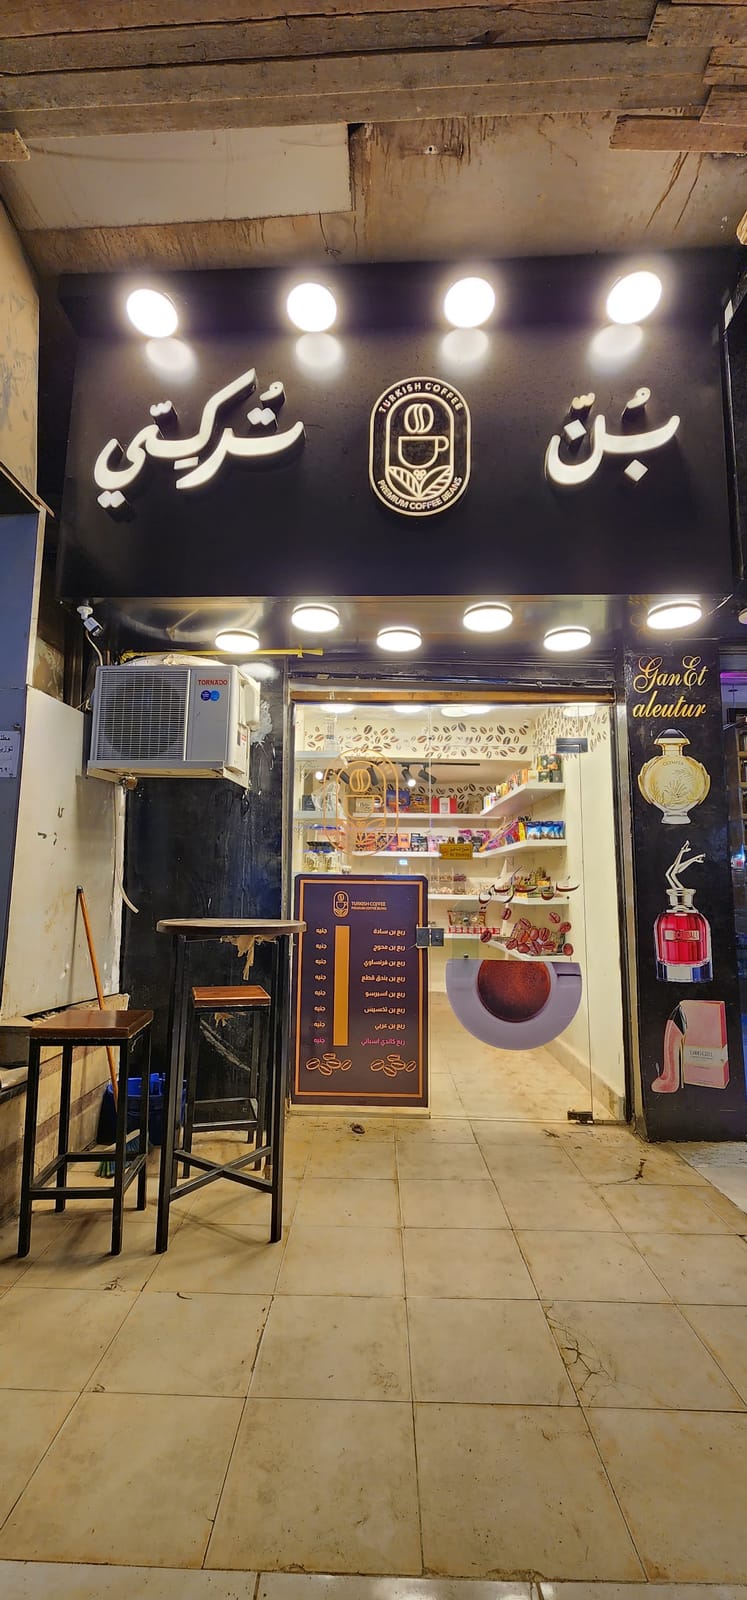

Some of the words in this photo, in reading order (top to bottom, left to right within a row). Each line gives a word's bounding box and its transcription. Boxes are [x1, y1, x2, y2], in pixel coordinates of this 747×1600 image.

[378, 382, 421, 413] TURKISH
[425, 382, 464, 411] COFFEE
[377, 479, 409, 509] PREMIUM
[409, 498, 443, 510] COFFEE
[441, 476, 463, 502] BEANS
[632, 690, 707, 718] aleutur
